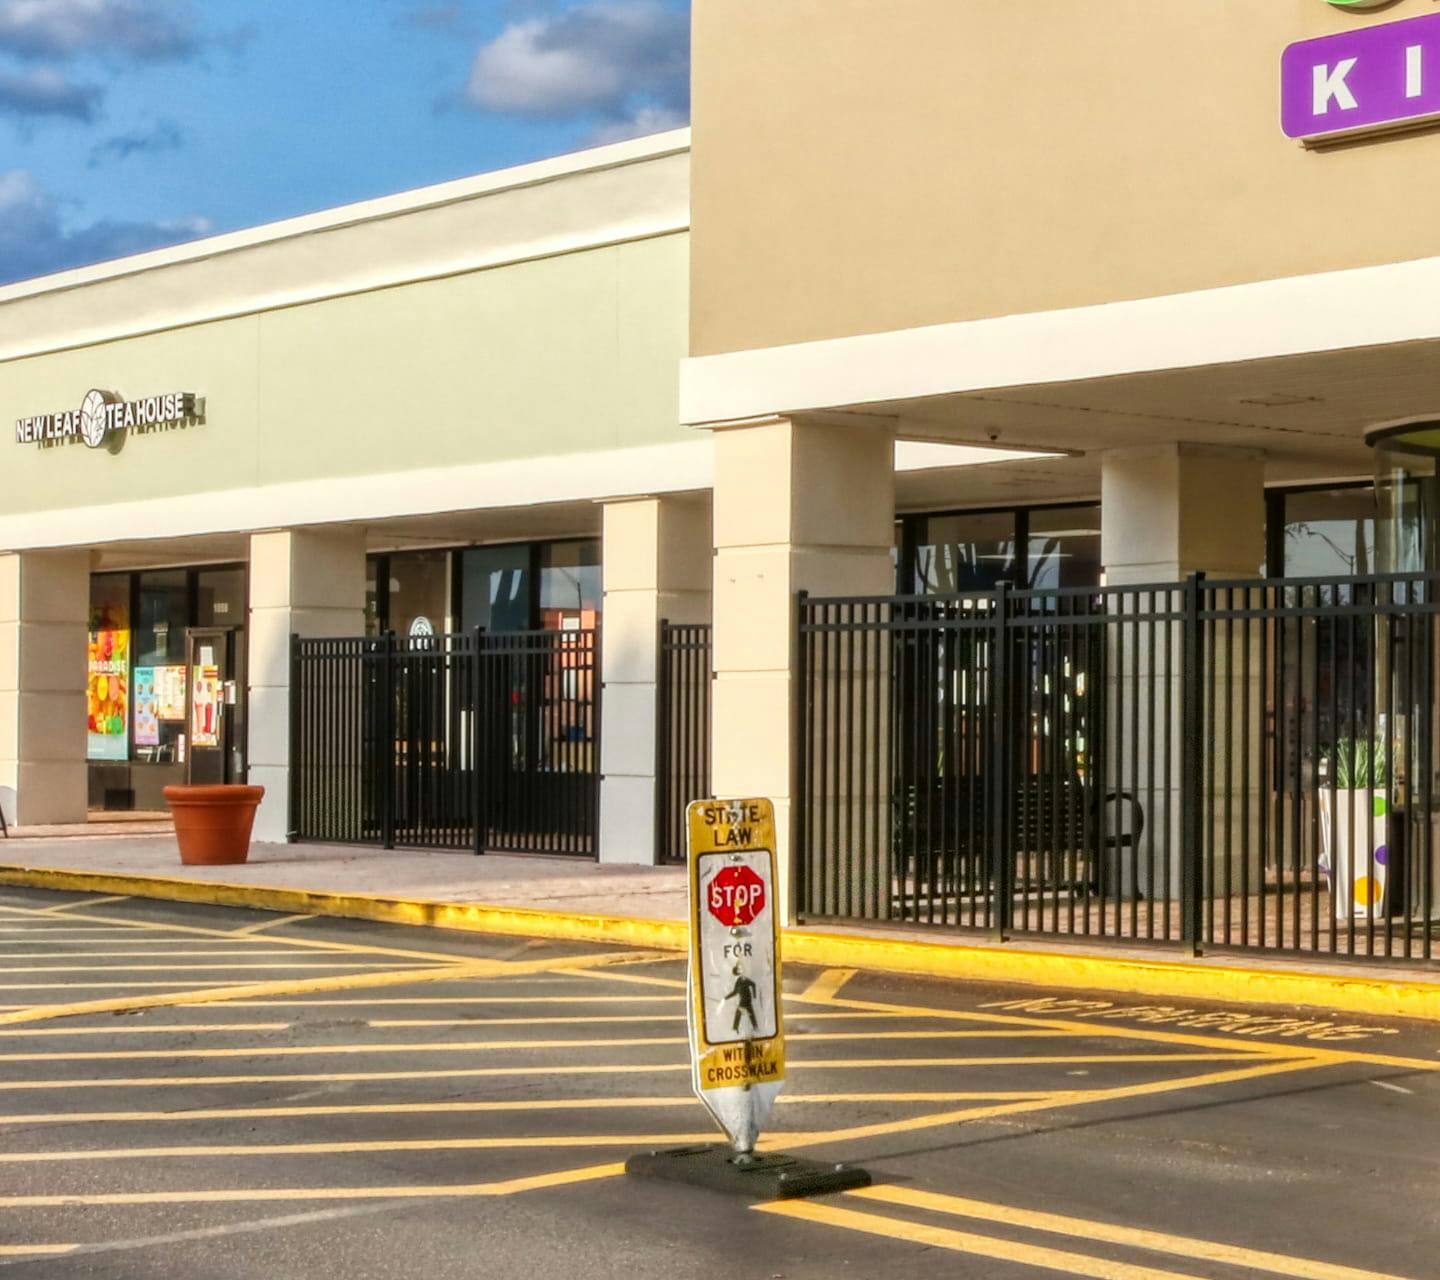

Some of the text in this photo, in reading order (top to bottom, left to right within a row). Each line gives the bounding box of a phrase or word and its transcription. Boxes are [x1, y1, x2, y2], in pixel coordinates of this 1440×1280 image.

[16, 392, 184, 443] NEW LEAF TEA HOUSE
[714, 827, 753, 847] LAW
[710, 882, 762, 909] STOP
[723, 943, 753, 959] FOR
[707, 1061, 778, 1082] CROSSWALK
